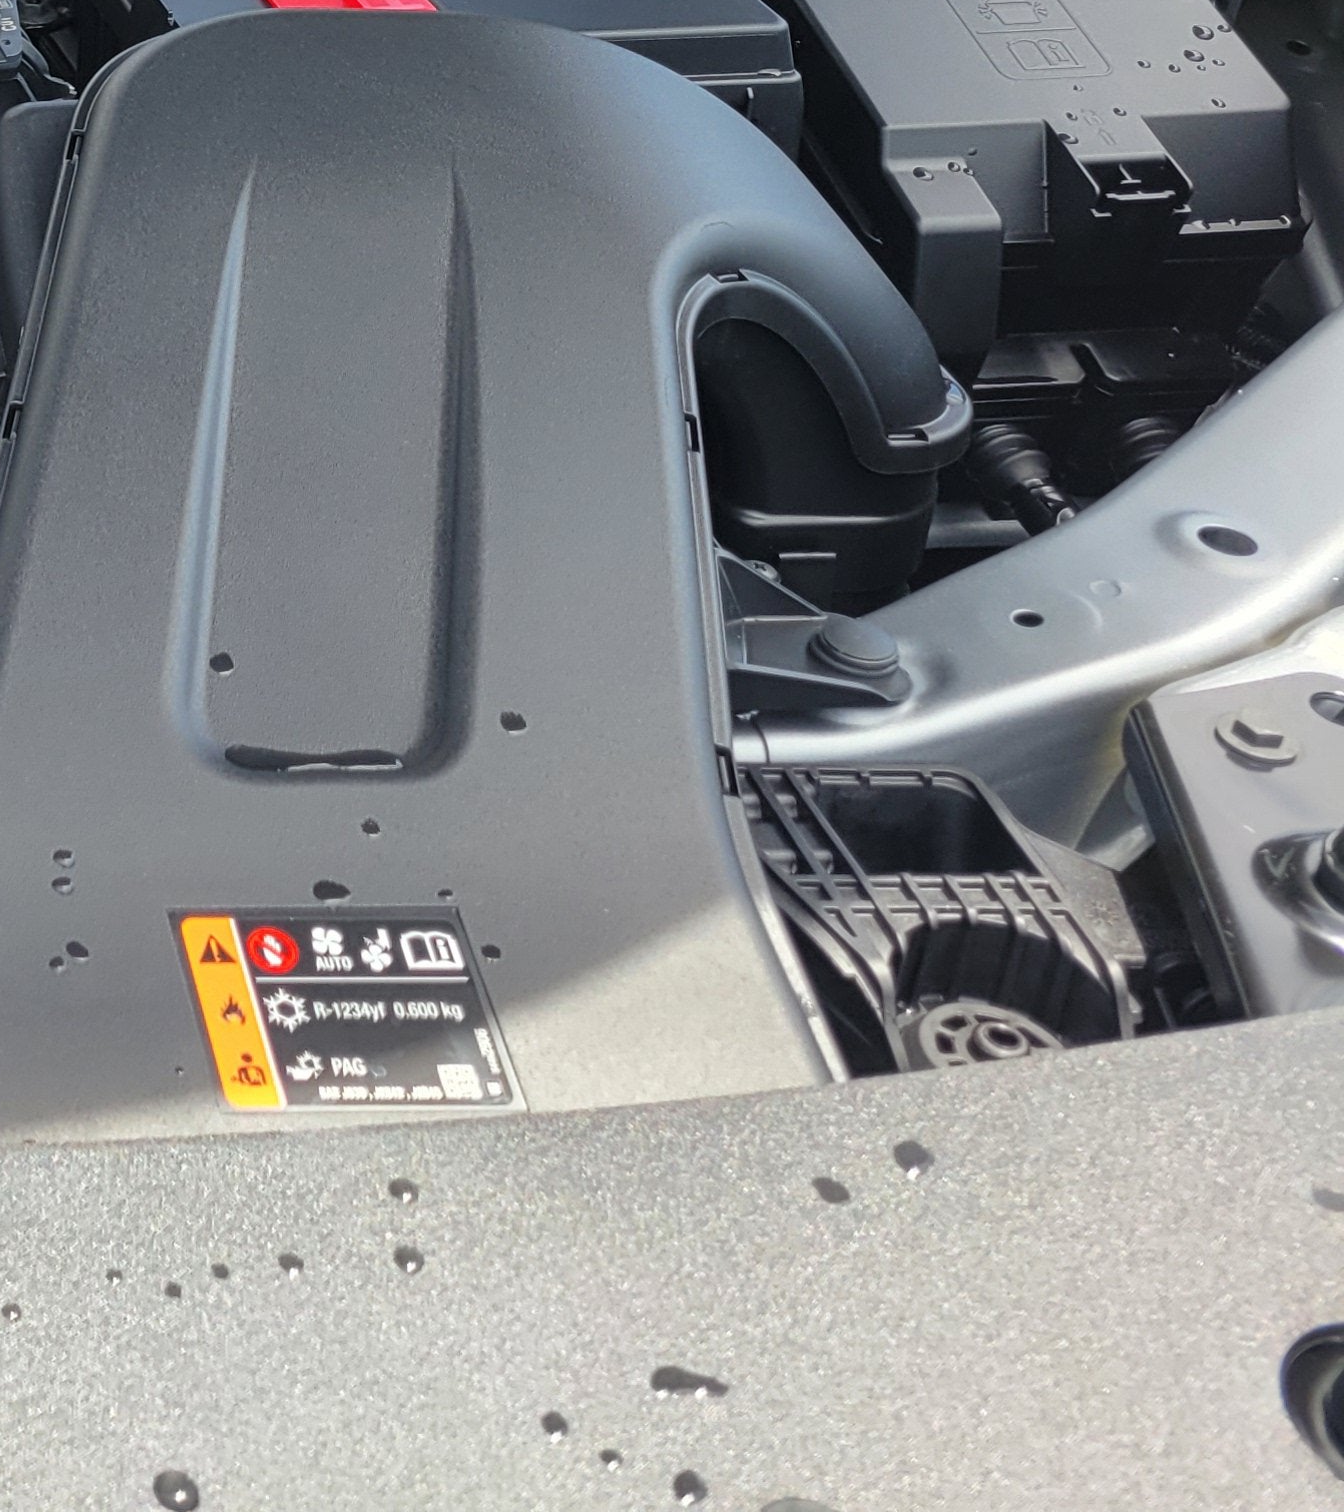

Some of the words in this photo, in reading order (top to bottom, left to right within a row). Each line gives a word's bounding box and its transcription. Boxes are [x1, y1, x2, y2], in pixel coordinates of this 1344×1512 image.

[315, 956, 353, 972] AUTO
[312, 1000, 386, 1023] R-1234yf
[393, 1000, 440, 1020] 0.600
[440, 1000, 465, 1023] kg
[330, 1056, 369, 1077] PAG
